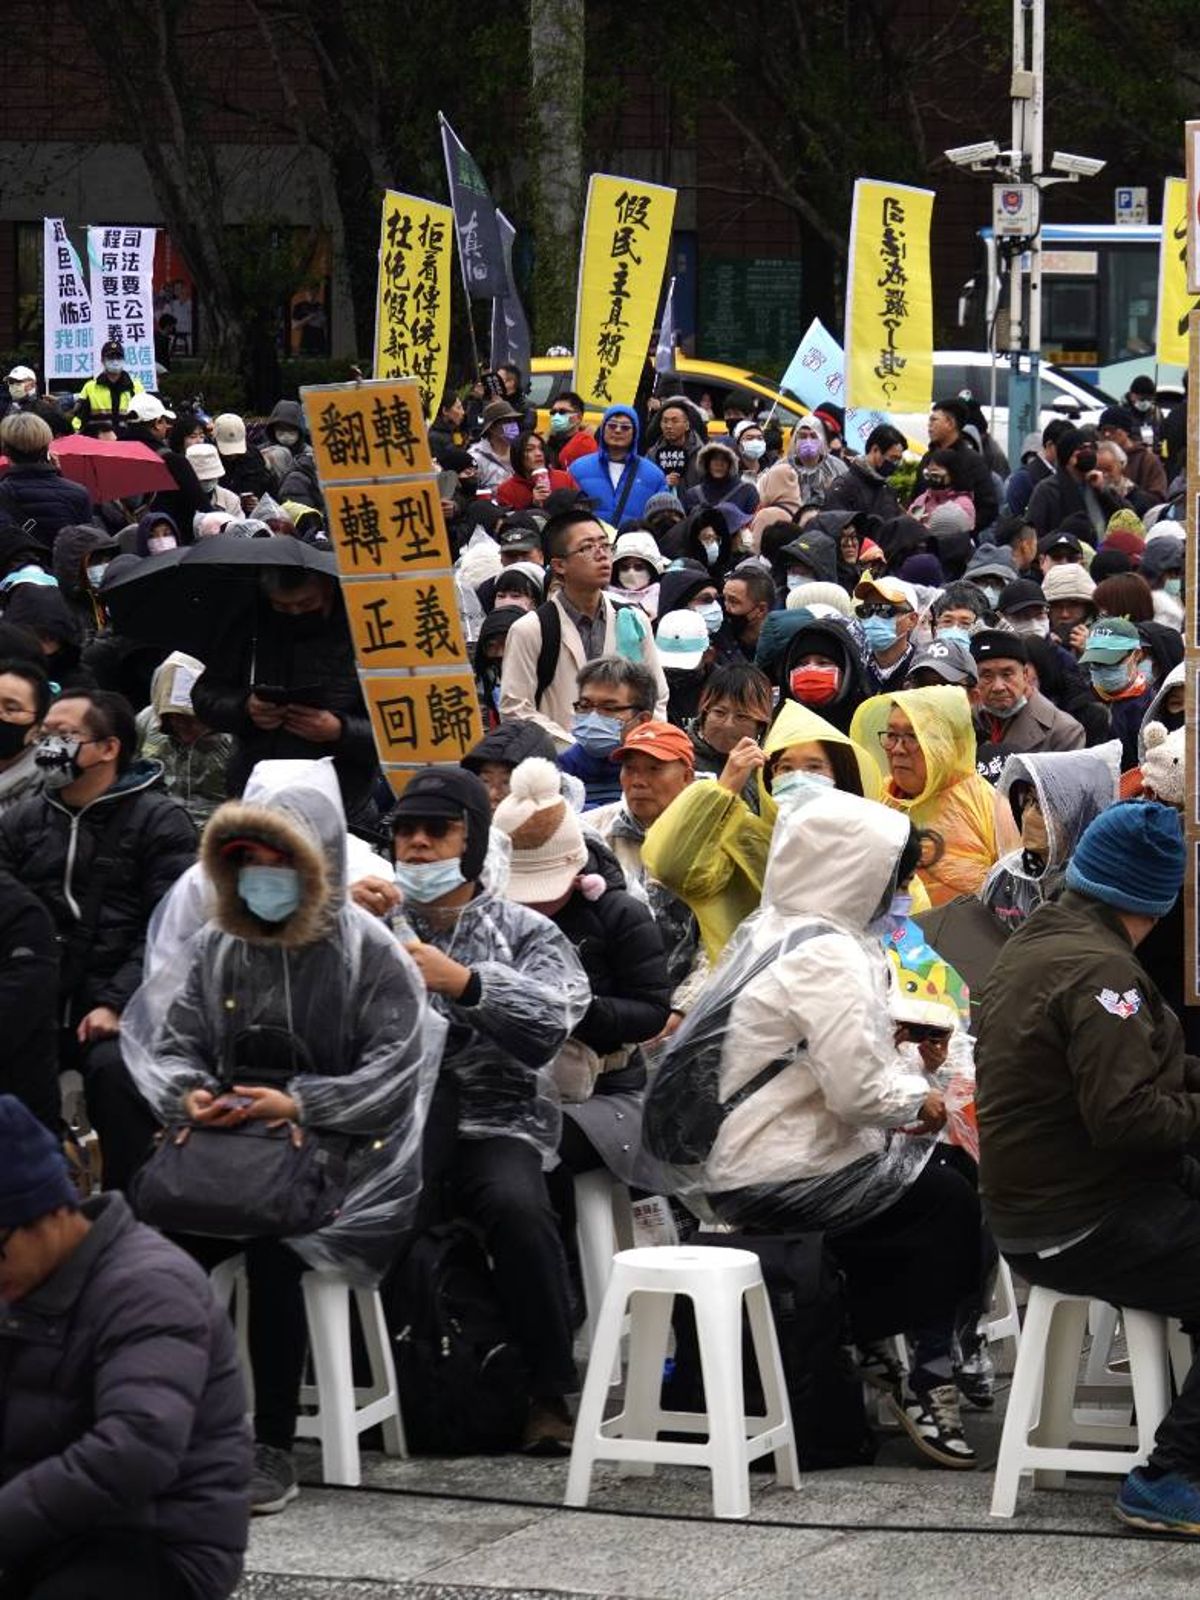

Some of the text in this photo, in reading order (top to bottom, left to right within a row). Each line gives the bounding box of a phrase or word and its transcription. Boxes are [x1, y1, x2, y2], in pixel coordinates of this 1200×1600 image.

[101, 229, 125, 344] 程序要正義
[121, 229, 146, 343] 司法要公平
[383, 208, 414, 377] 杜絕假新
[318, 394, 421, 468] 翻轉
[339, 490, 442, 566] 轉型
[360, 585, 460, 657] 正義
[376, 684, 474, 754] 回歸
